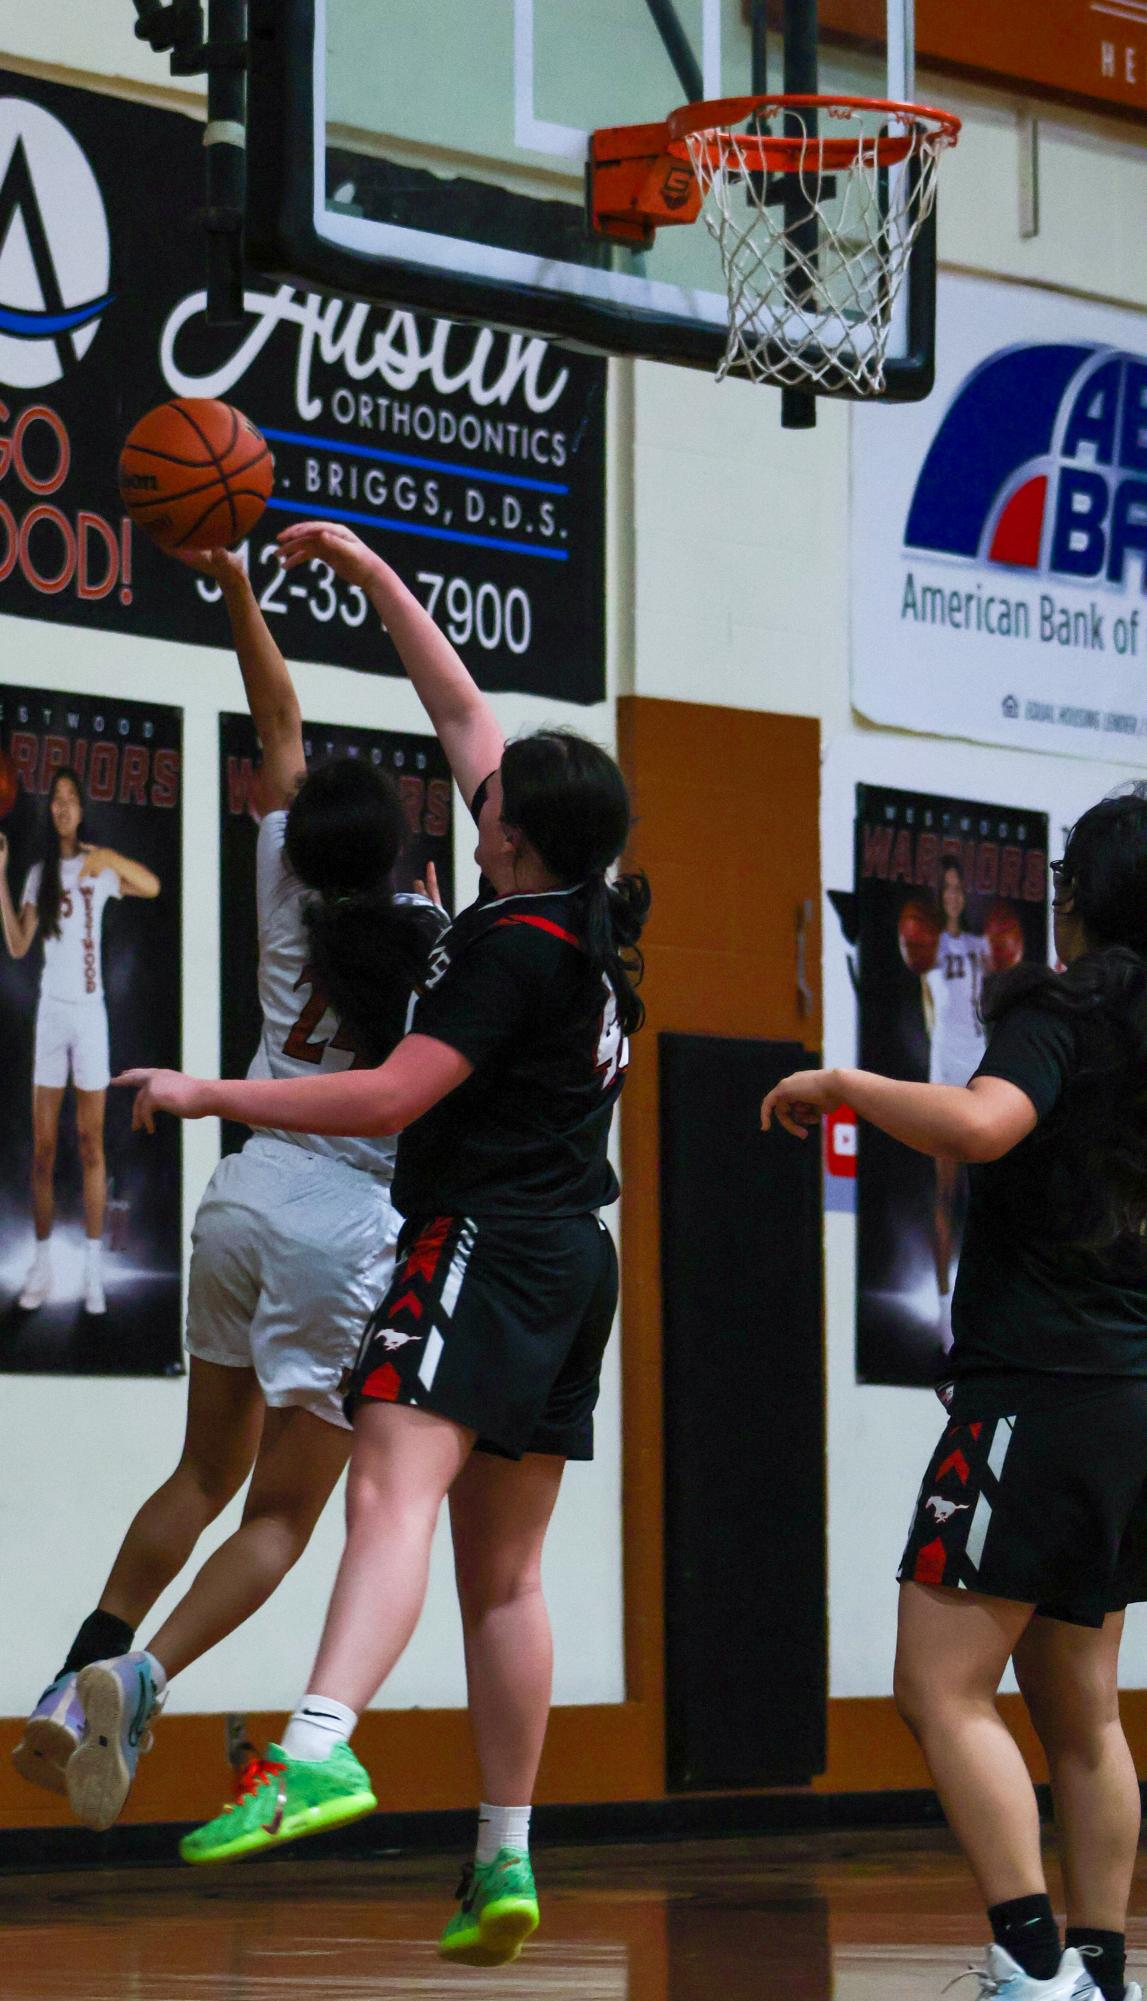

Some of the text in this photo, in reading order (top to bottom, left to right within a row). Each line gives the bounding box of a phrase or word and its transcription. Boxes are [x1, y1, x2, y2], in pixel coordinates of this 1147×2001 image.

[0, 404, 71, 495] O
[332, 388, 568, 467] ORTHODONTICS
[305, 459, 453, 526] BRIGGS,
[465, 488, 569, 540] D.D.S.
[902, 573, 1139, 656] American Bank of
